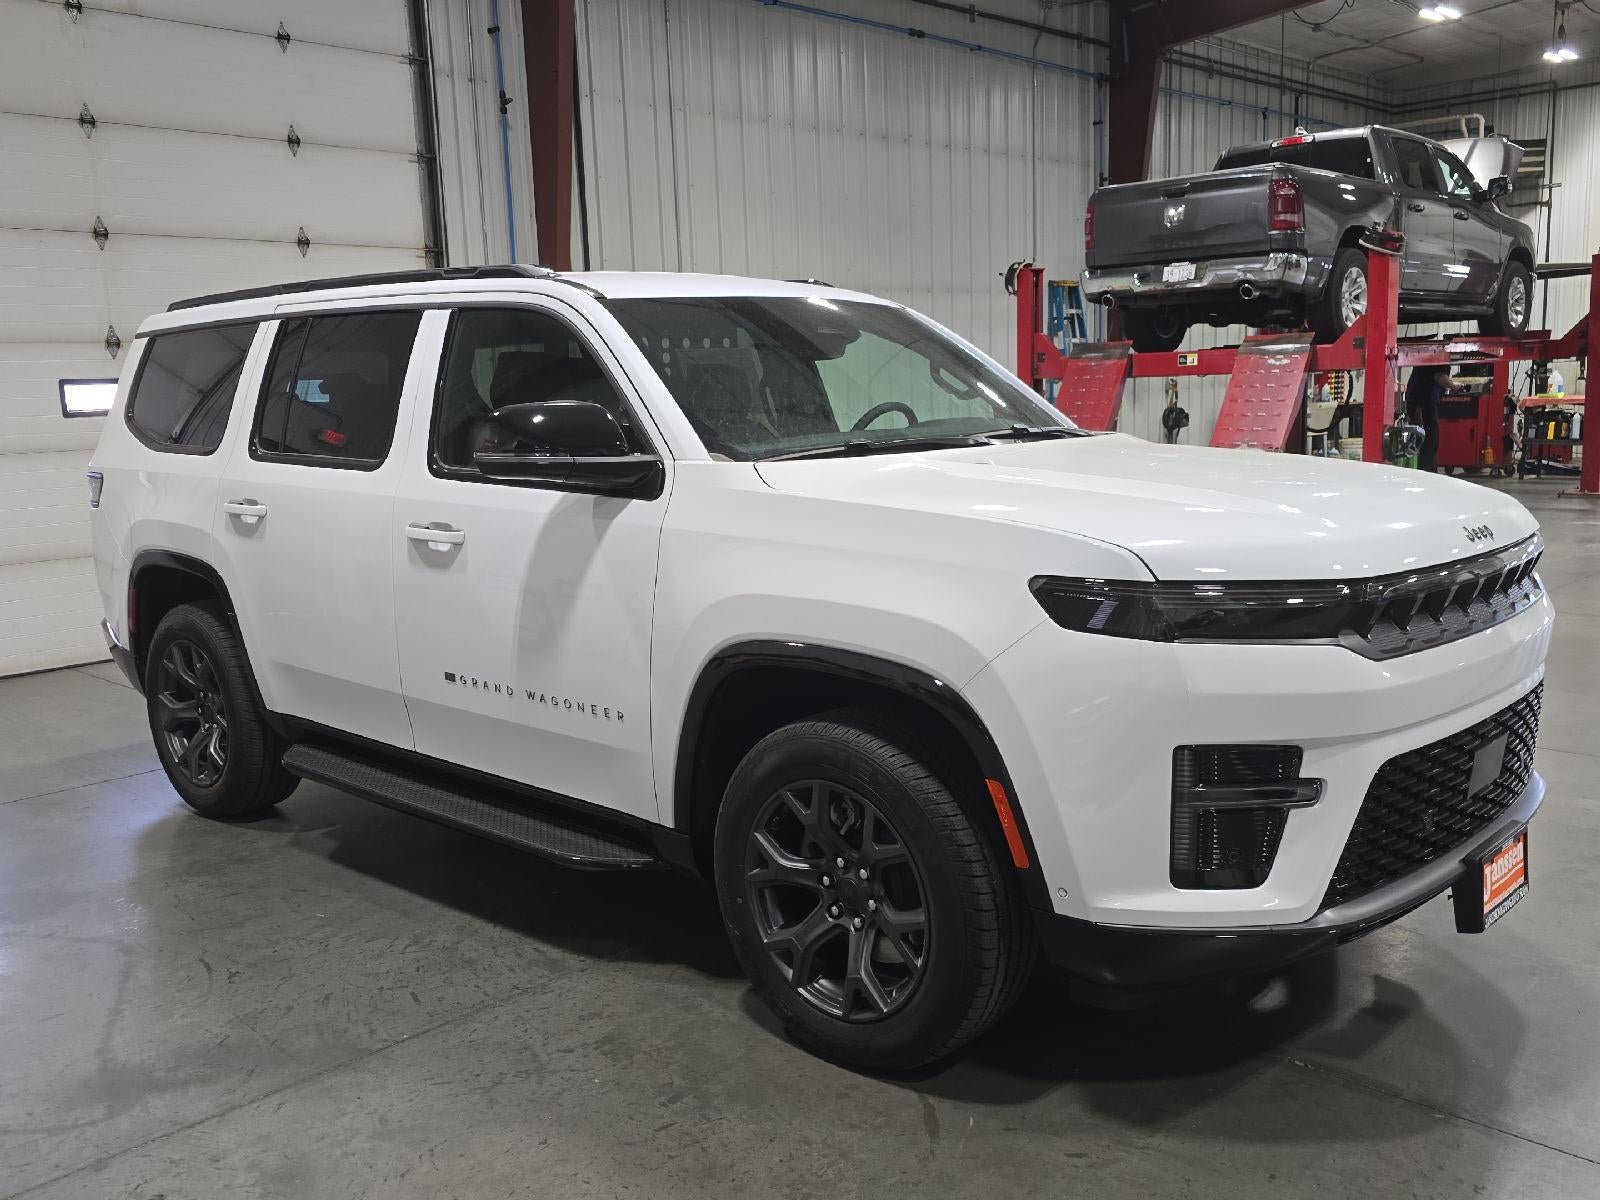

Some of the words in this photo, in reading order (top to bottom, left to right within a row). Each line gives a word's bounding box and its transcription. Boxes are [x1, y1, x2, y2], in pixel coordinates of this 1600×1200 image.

[1462, 525, 1494, 542] Jeep
[459, 675, 514, 696] GRAND
[525, 689, 625, 721] WAGONEER
[1484, 842, 1524, 902] Janssen
